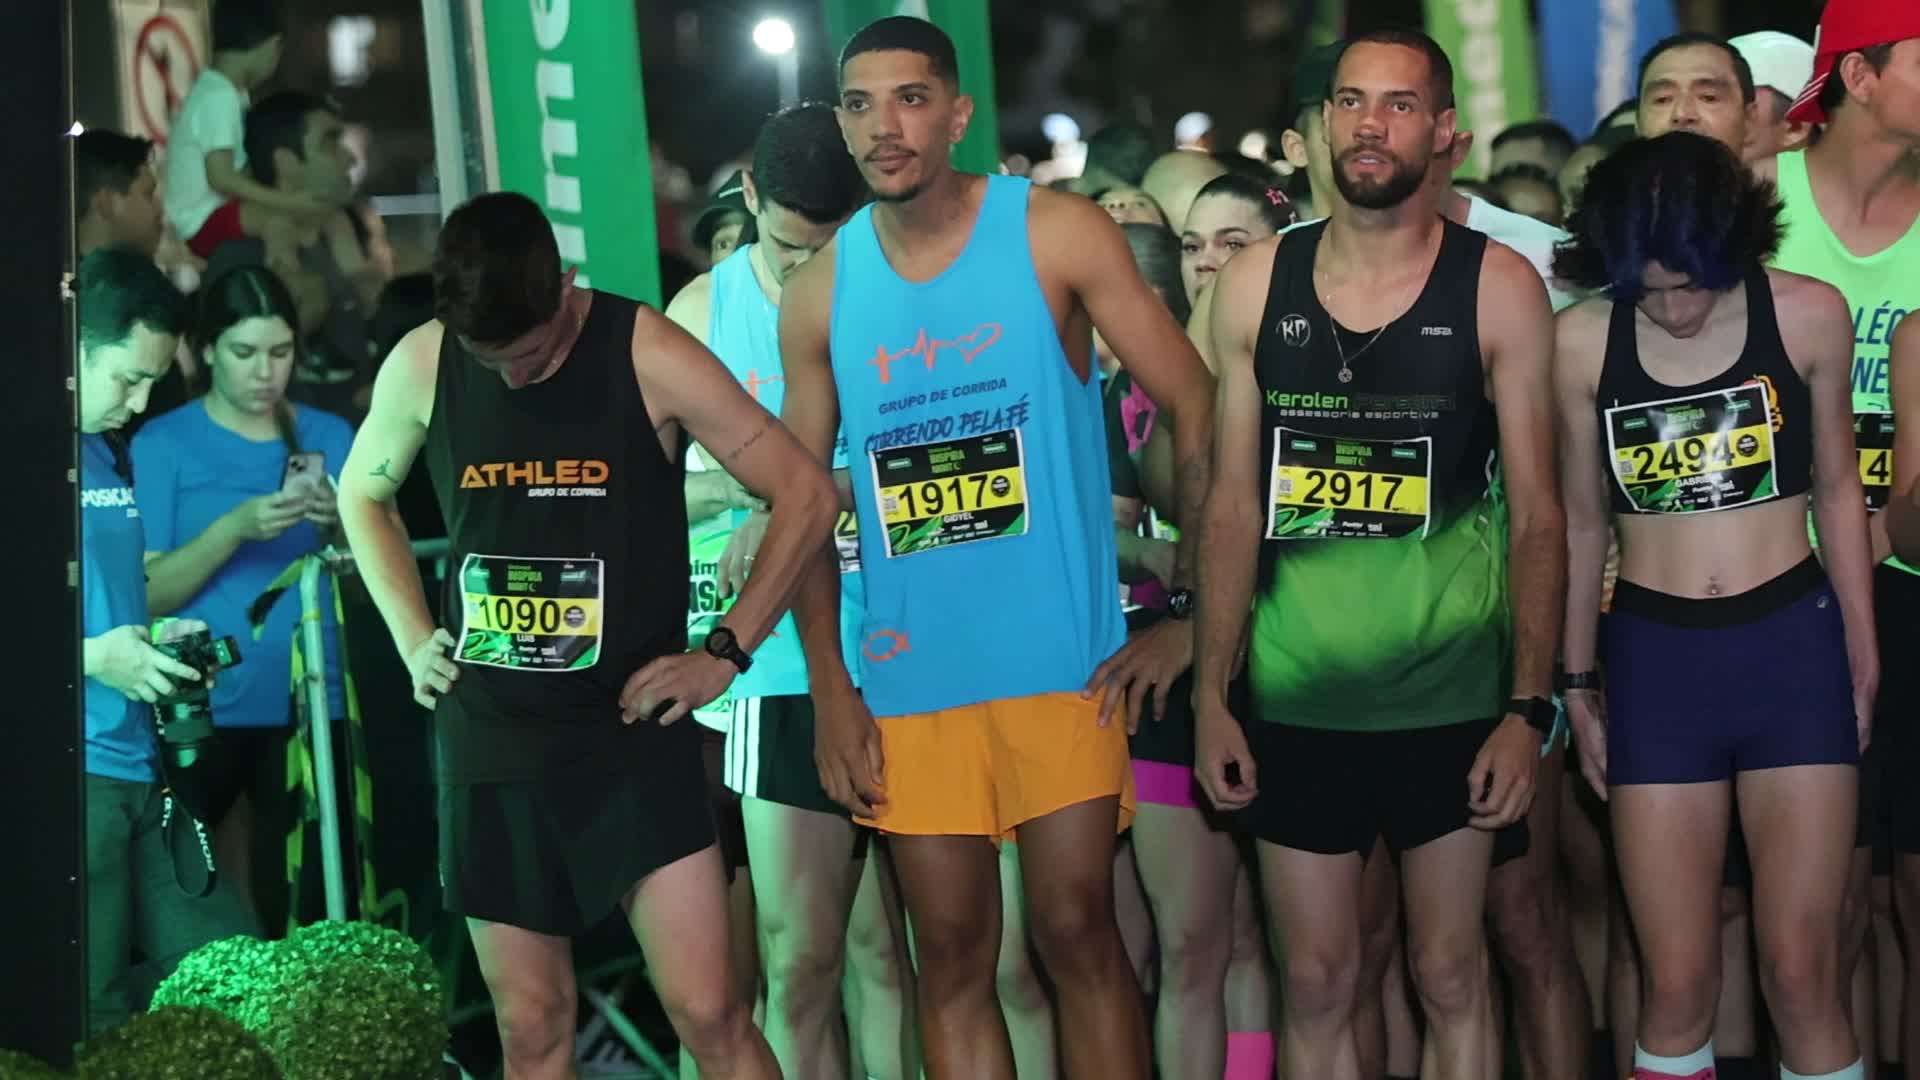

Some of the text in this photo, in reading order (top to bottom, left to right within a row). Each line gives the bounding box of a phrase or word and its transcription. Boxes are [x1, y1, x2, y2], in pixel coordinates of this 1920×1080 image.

[879, 377, 1007, 414] GRUPO DE CORRIDA
[1266, 389, 1349, 409] Kerolen
[959, 405, 1005, 436] PELA
[1006, 393, 1031, 428] FÉ
[1365, 410, 1439, 420] esportiva
[460, 459, 609, 489] ATHLED
[1303, 470, 1404, 510] 2917
[898, 474, 988, 518] 1917
[479, 597, 561, 634] 1090
